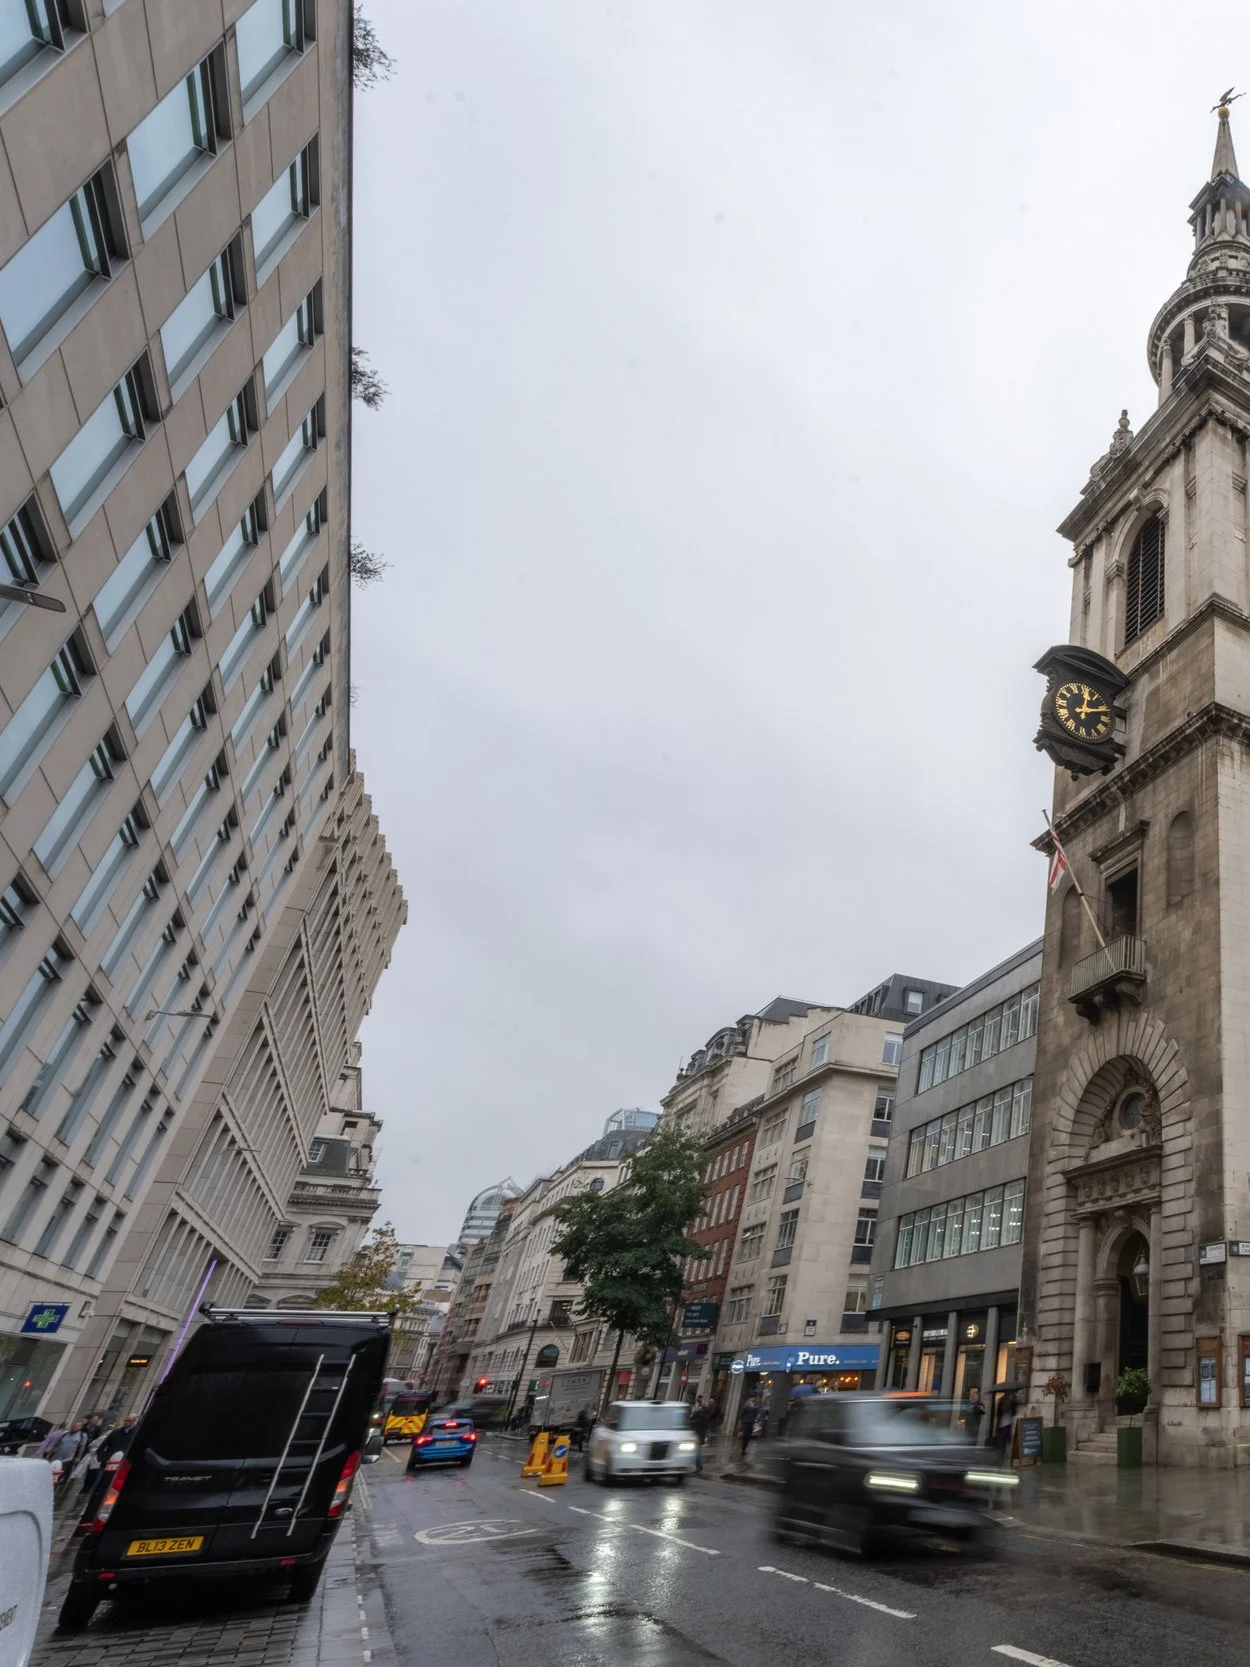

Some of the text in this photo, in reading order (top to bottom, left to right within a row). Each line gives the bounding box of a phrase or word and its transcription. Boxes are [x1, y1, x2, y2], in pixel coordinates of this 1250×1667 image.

[796, 1351, 840, 1366] Pure.
[137, 1539, 196, 1553] BL13 ZEN
